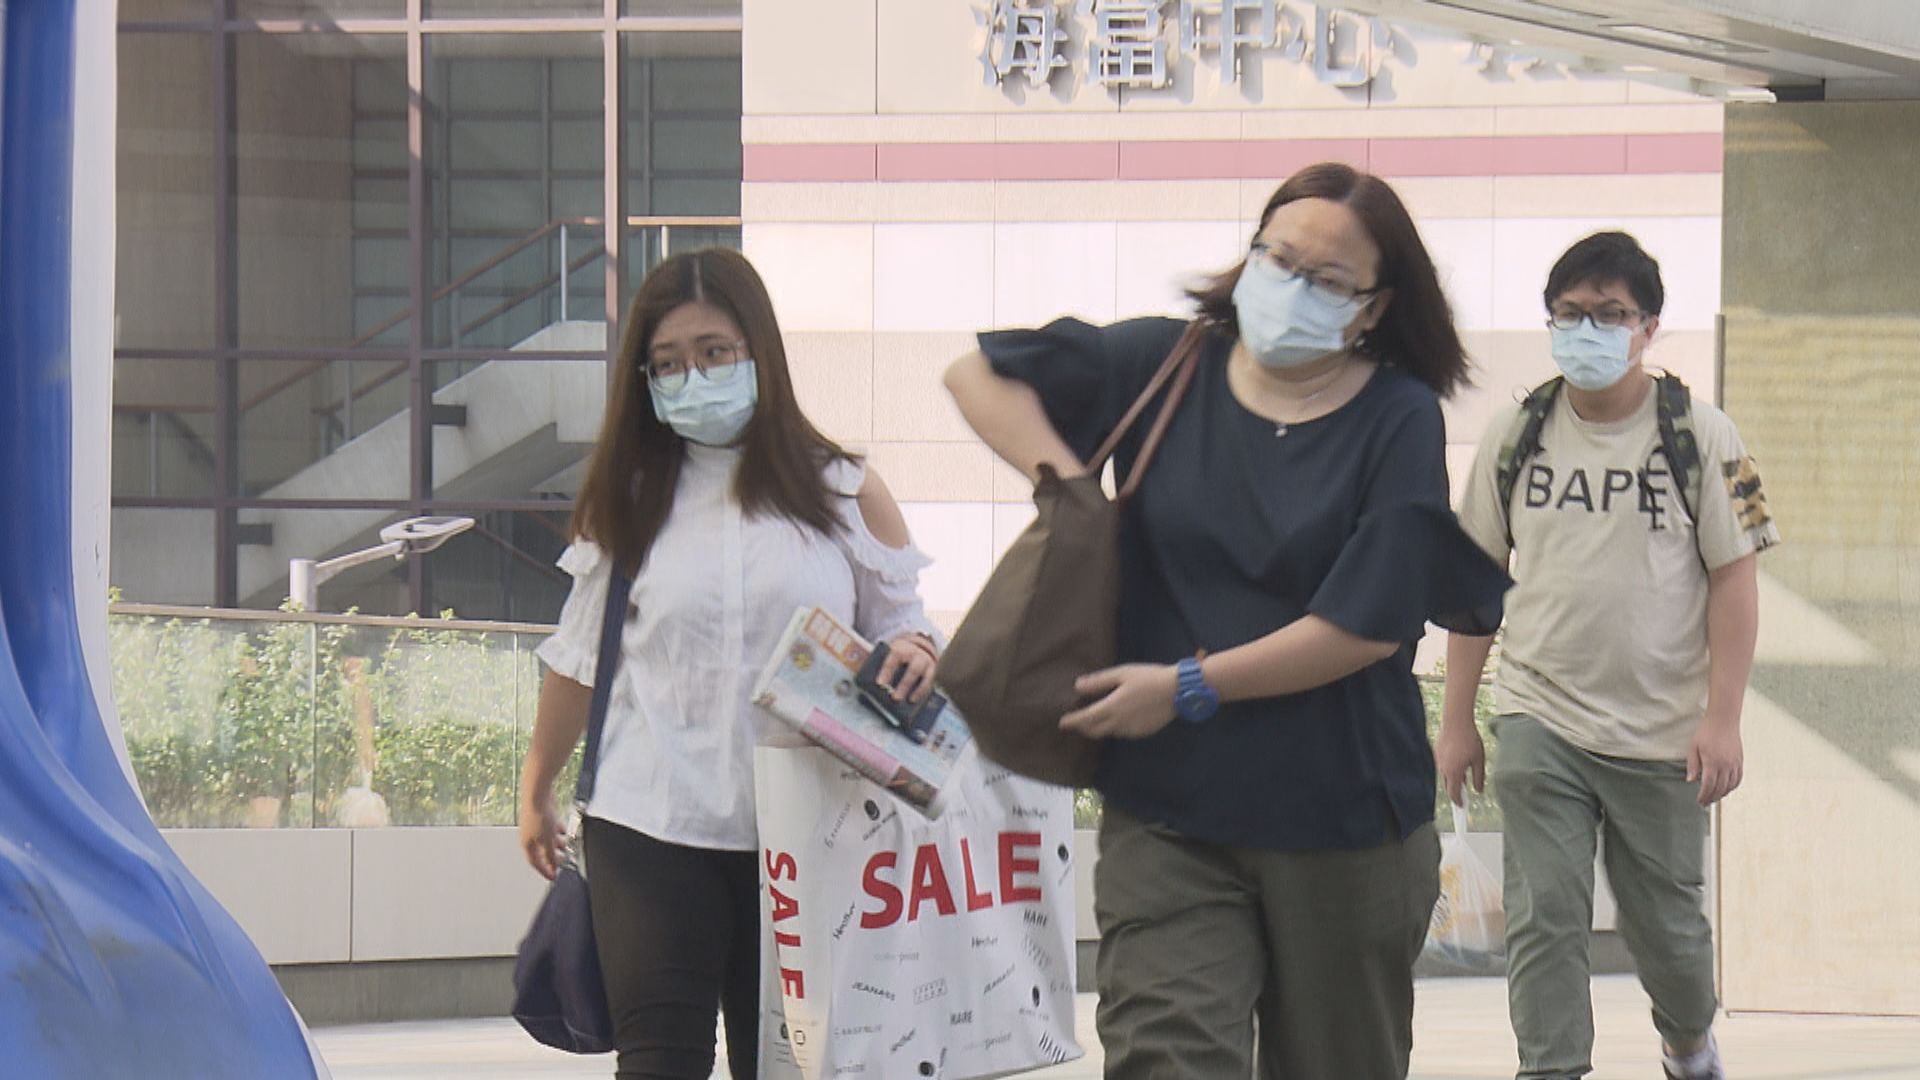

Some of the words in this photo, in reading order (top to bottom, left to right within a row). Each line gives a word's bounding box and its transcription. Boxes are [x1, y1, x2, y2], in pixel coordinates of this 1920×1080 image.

[972, 0, 1394, 89] 海富中心
[1524, 465, 1669, 513] BAPE
[765, 848, 805, 1000] SALE
[859, 831, 1043, 930] SALE
